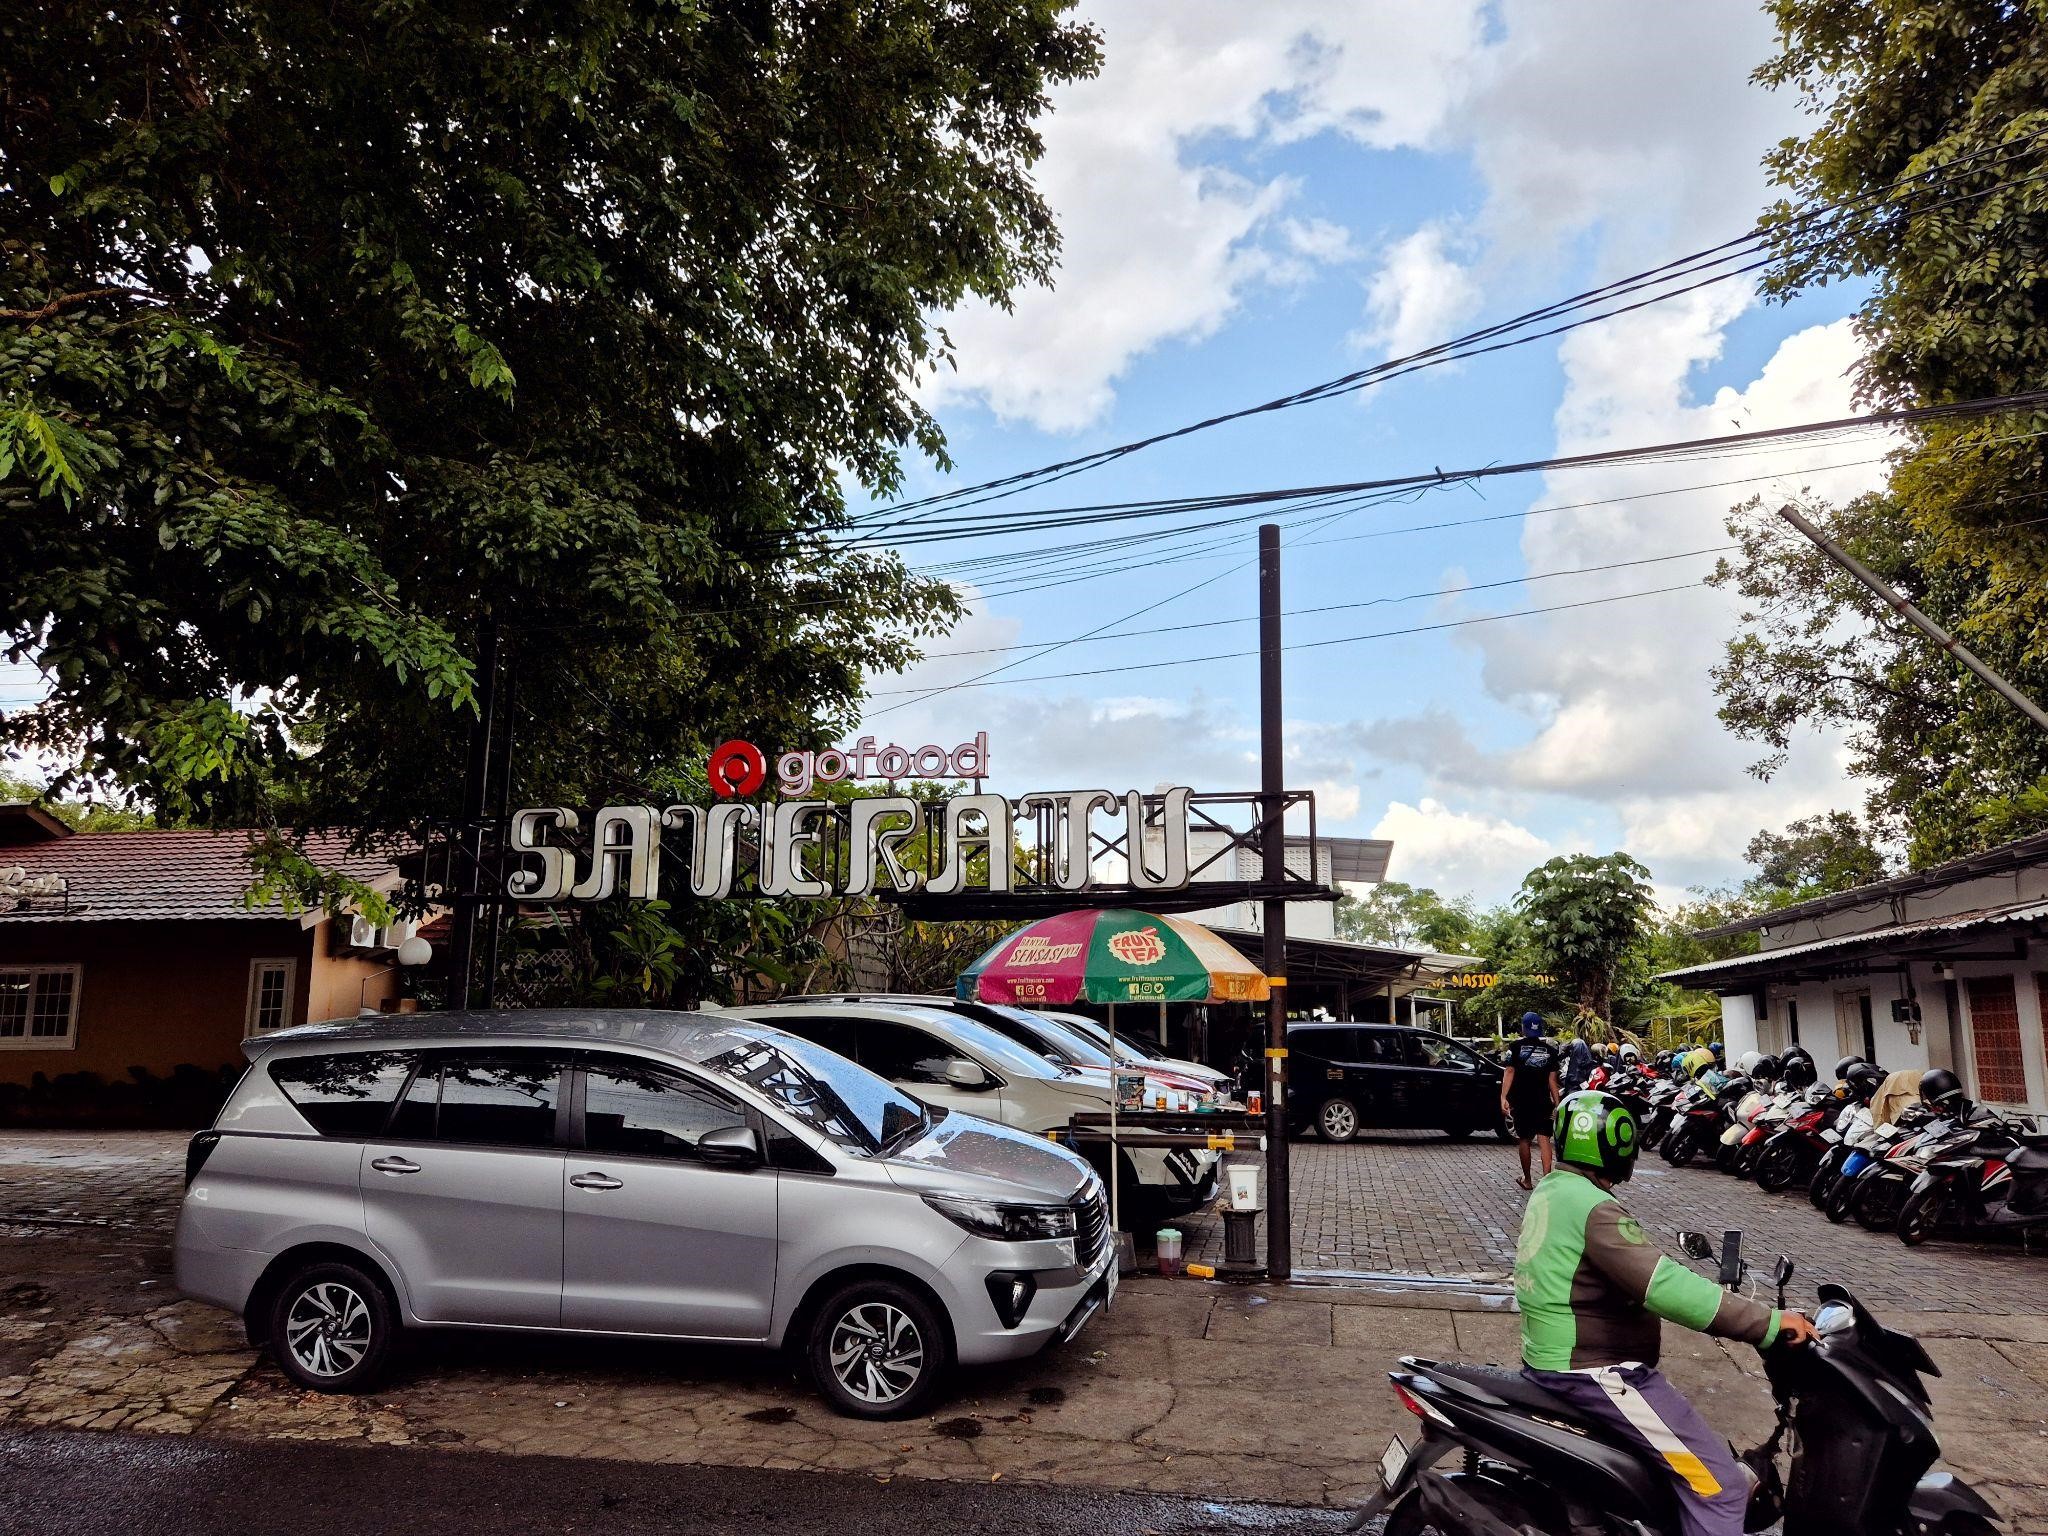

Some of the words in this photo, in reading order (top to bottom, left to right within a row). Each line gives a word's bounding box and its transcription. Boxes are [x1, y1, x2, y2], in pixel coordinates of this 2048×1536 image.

[777, 731, 989, 796] gofood
[1113, 934, 1157, 948] FRUIT
[1115, 946, 1159, 961] TEA
